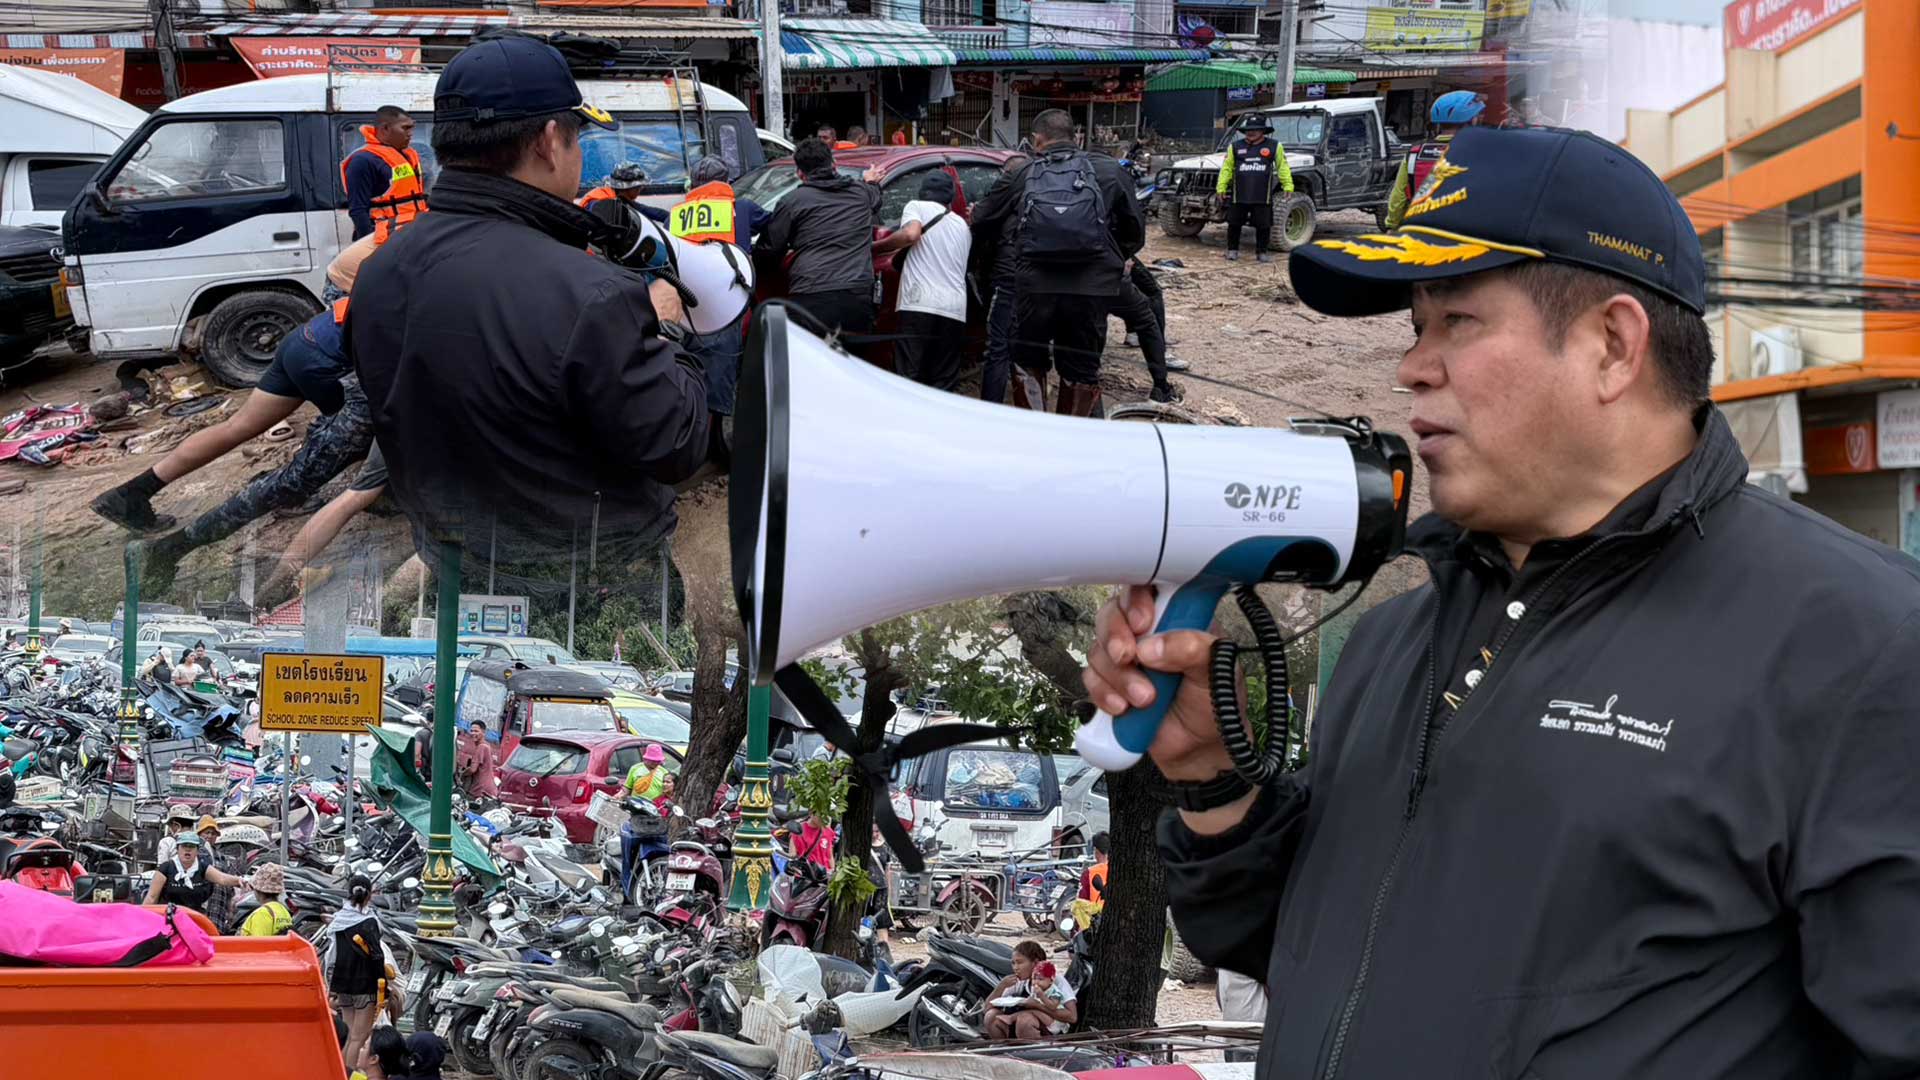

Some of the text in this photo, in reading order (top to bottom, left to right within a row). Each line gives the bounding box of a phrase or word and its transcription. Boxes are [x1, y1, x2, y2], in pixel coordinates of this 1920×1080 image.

[679, 203, 720, 232] ทอ.
[1587, 231, 1665, 267] THAMANAT P.
[1254, 484, 1302, 510] NPE
[1242, 511, 1286, 522] SR-66
[276, 659, 368, 682] เขตโรงเรียน
[283, 686, 360, 705] ลดความเร็ว
[266, 713, 375, 727] SCHOOL ZONE REDUCE SPEED
